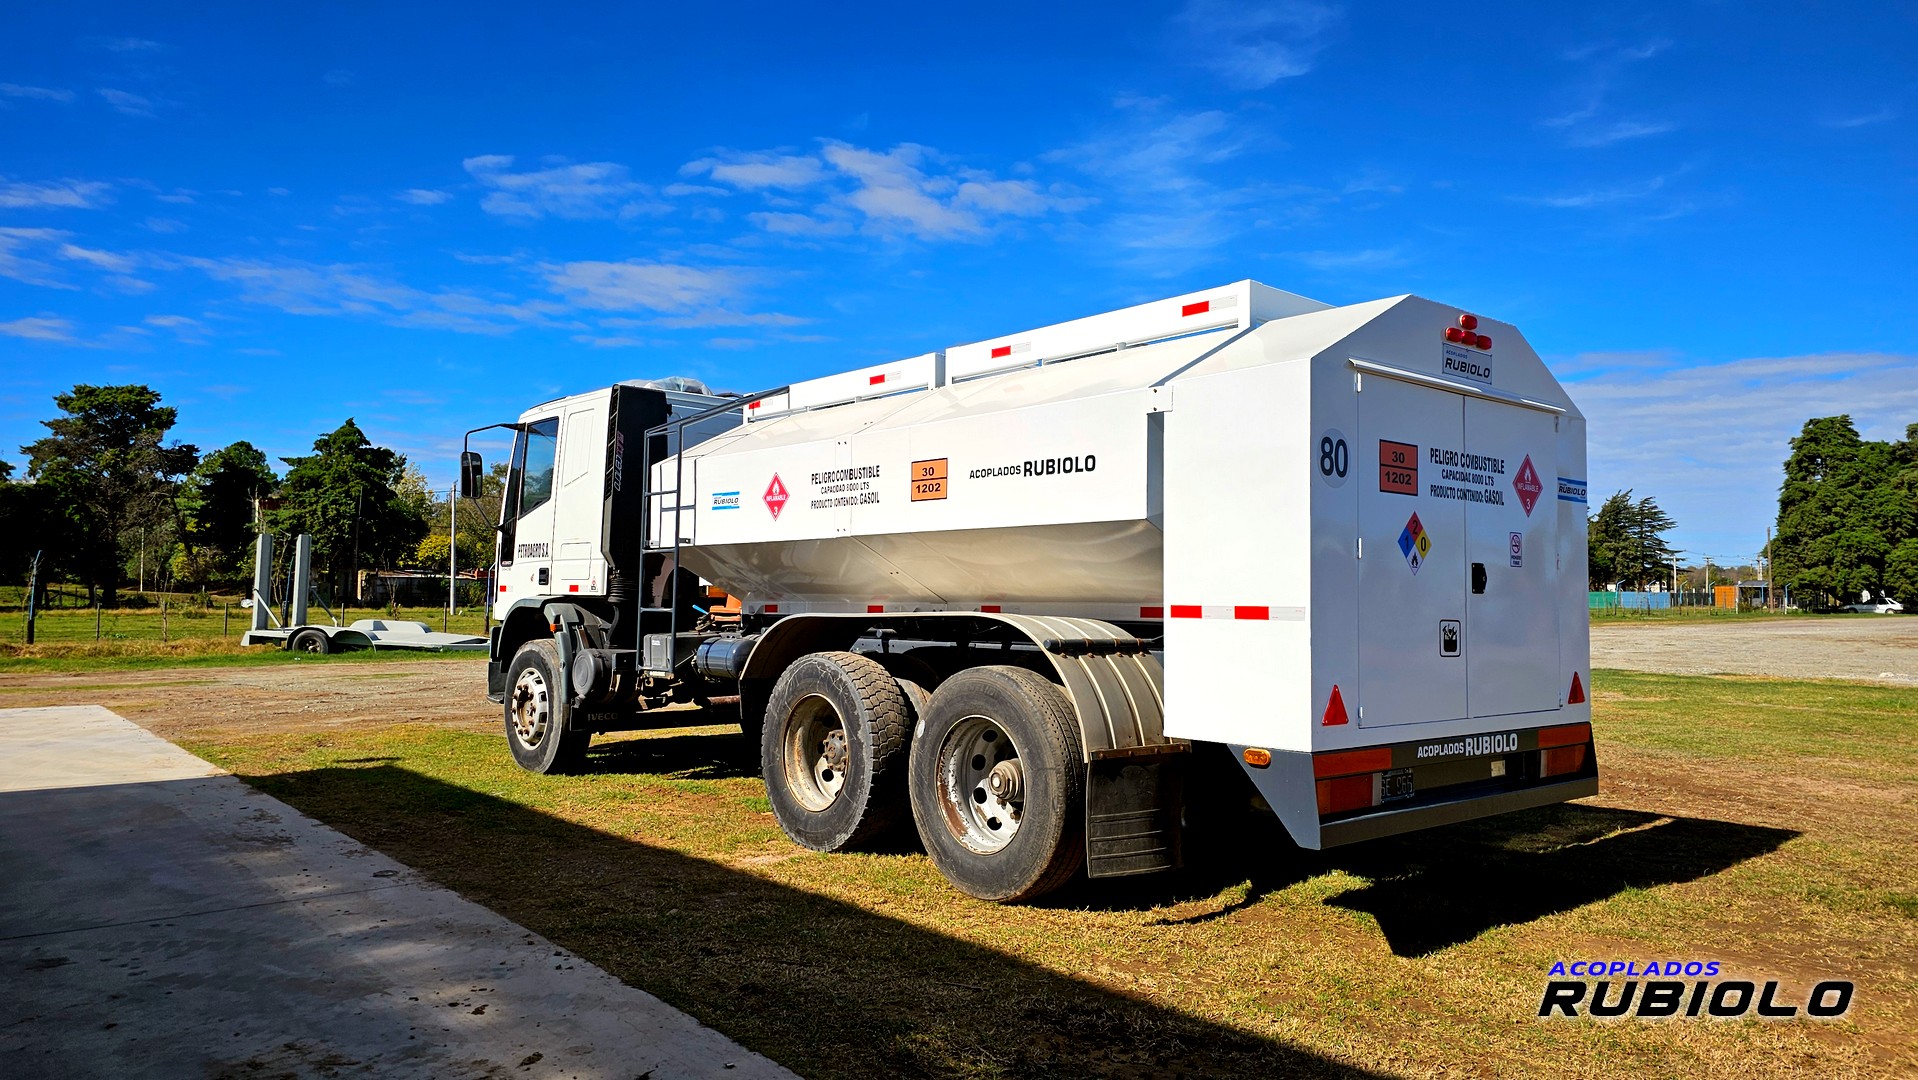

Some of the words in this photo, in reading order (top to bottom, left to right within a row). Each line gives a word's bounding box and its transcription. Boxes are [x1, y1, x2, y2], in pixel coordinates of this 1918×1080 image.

[1445, 357, 1491, 378] RUBIOLO
[1320, 436, 1348, 478] 80
[1392, 451, 1405, 464] 30
[1430, 447, 1459, 467] PELIGRO
[1460, 453, 1505, 475] COMBUSTIBLE
[922, 466, 935, 477] 30
[969, 465, 1022, 479] ACOPLADOS
[1023, 454, 1096, 477] RUBIOLO
[1385, 471, 1412, 486] 1202
[1472, 473, 1484, 485] 8000
[1484, 475, 1495, 487] LTS
[860, 481, 870, 491] LTS
[915, 483, 941, 494] 1202
[1558, 486, 1586, 496] RUBIOLO
[714, 497, 739, 505] RUBIOLO
[859, 491, 880, 505] GASOIL
[1430, 484, 1456, 500] PRODUCTO
[1484, 488, 1505, 506] GASOIL
[773, 506, 779, 515] 3
[1526, 498, 1531, 510] 3
[1412, 519, 1418, 535] 2
[1404, 535, 1409, 550] 1
[1420, 536, 1426, 552] 0
[518, 543, 542, 558] PETROAGRO
[587, 712, 618, 722] IVECO
[1417, 742, 1464, 758] ACOPLADOS
[1465, 733, 1518, 756] RUBIOLO
